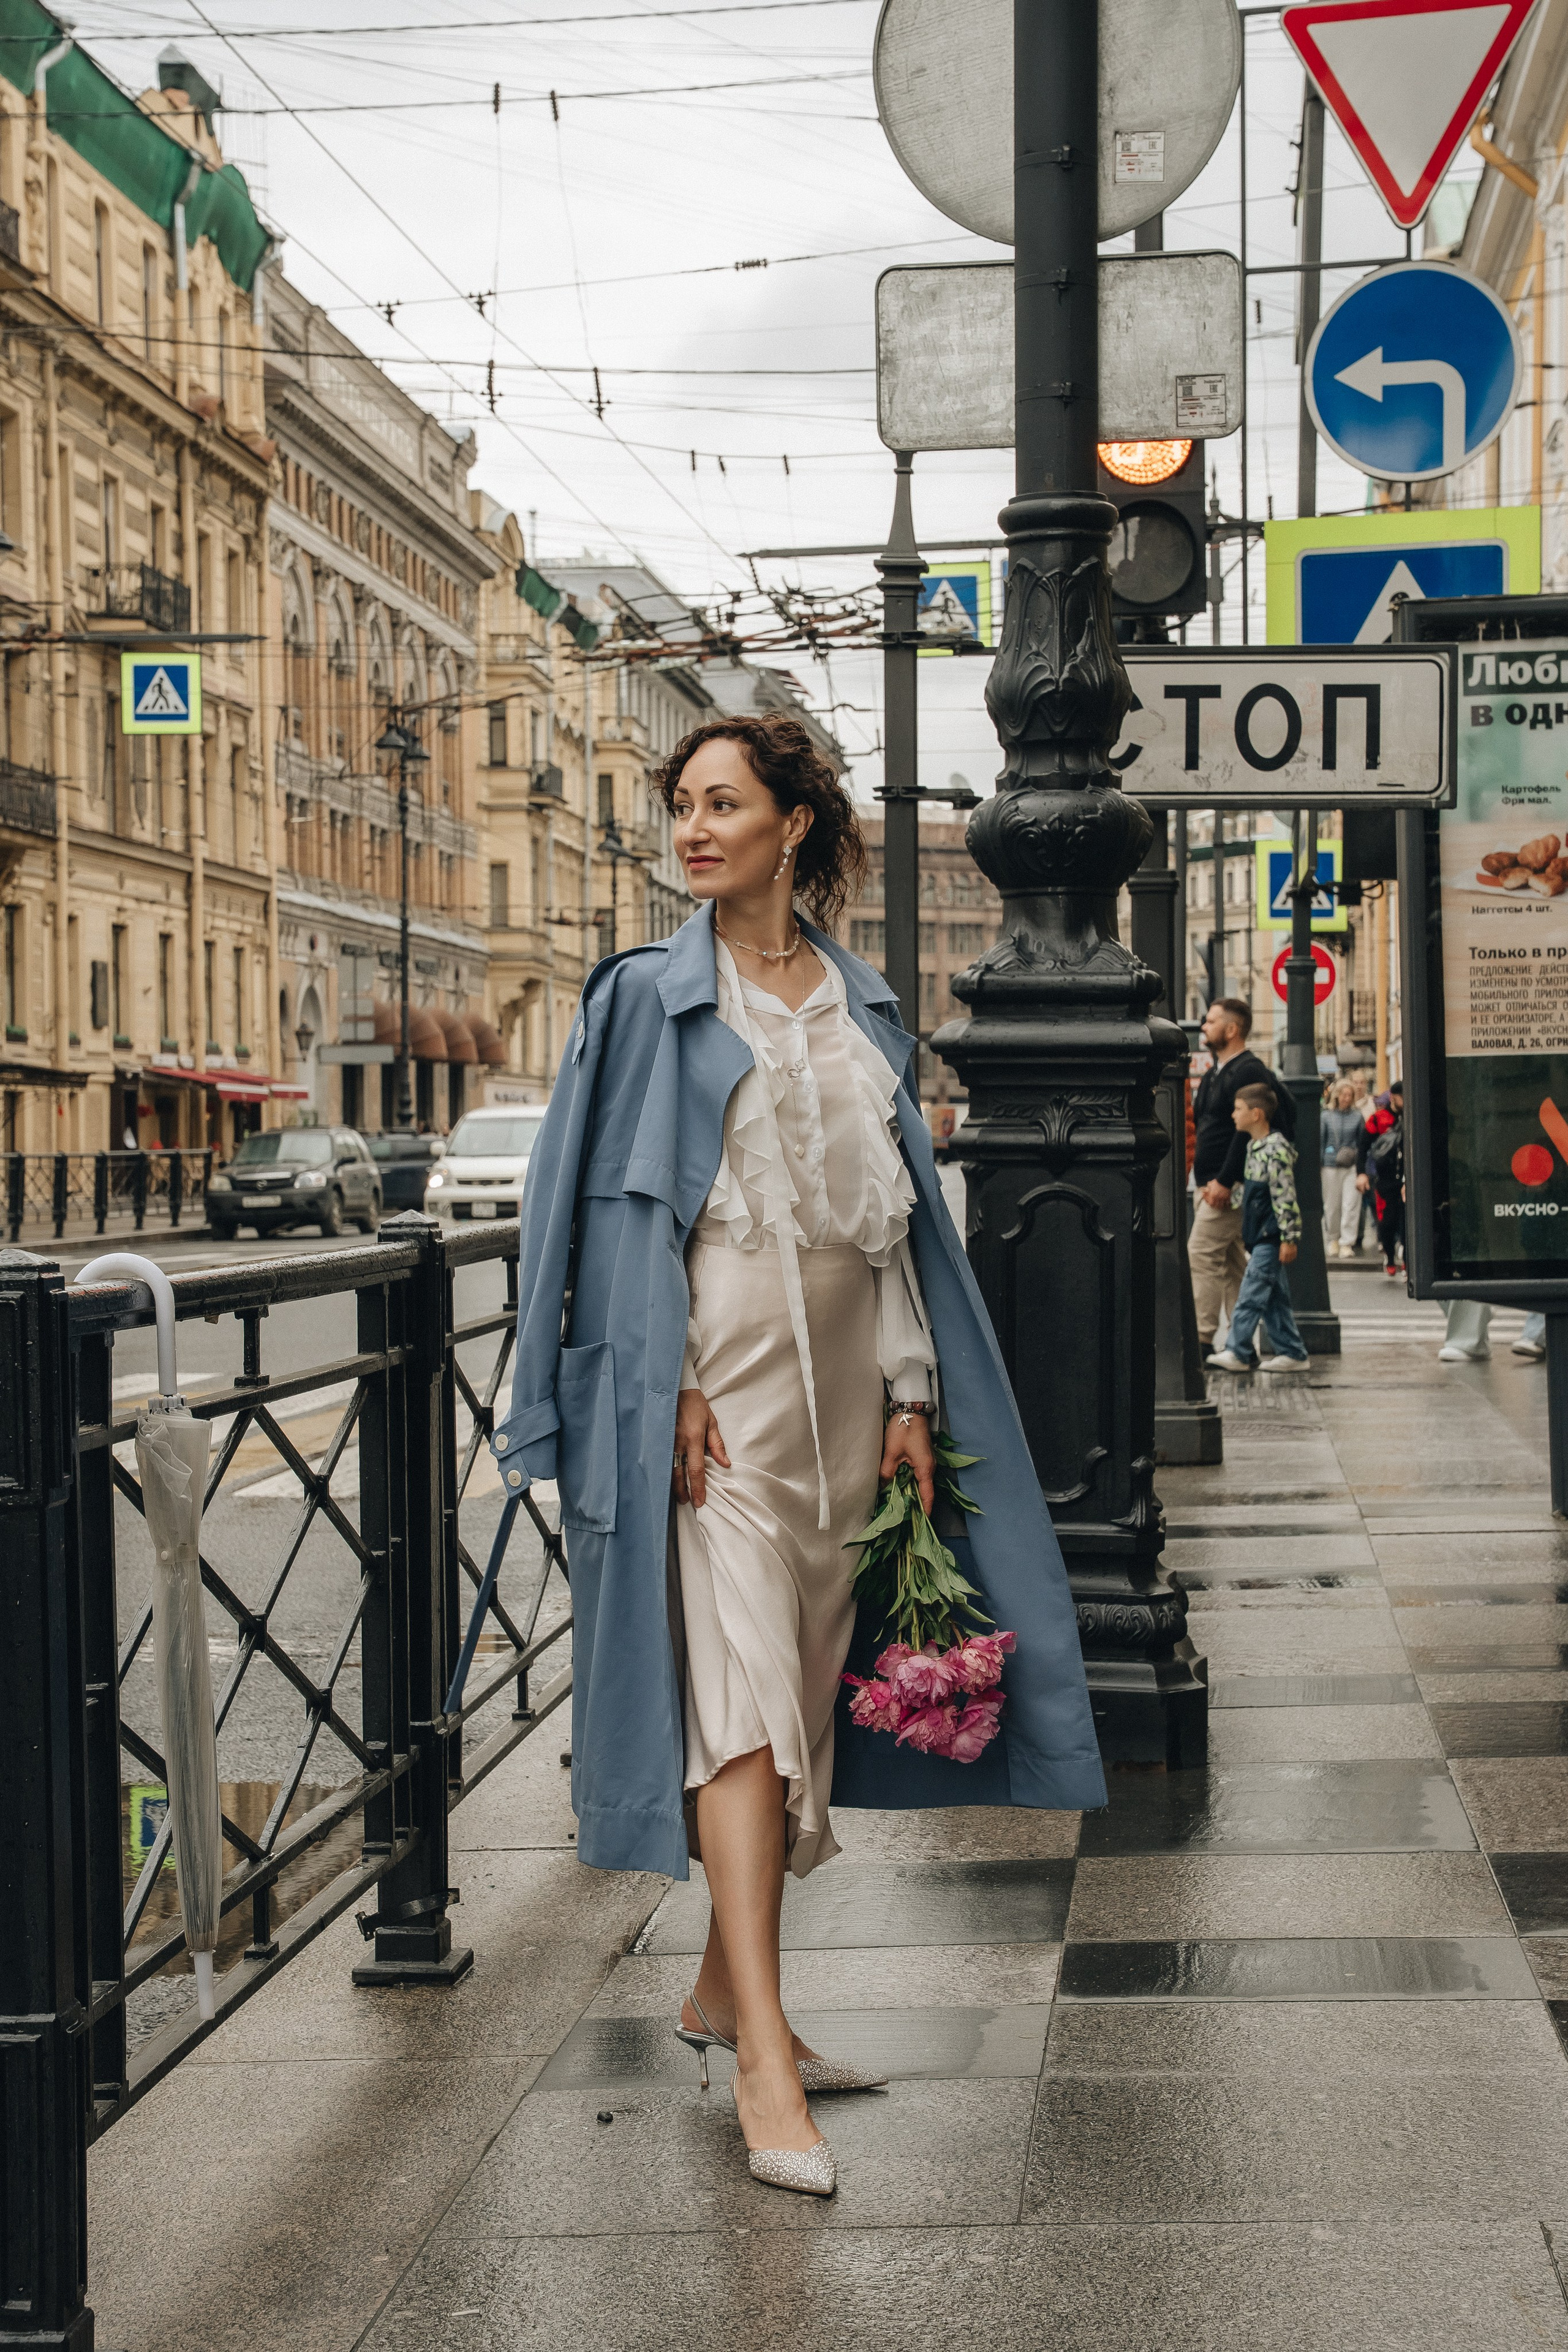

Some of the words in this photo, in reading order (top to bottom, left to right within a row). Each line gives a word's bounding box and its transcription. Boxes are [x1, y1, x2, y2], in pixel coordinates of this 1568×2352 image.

[1471, 705, 1494, 727] в
[1502, 785, 1561, 794] Картофель
[1501, 797, 1525, 806] Фри
[1472, 906, 1523, 914] Наггетсы
[1469, 947, 1527, 959] Только
[1532, 949, 1542, 957] в
[1470, 965, 1532, 977] ПРЕДЛОЖЕНИЕ
[1471, 978, 1517, 988] ИЗМЕНЕНЫ
[1521, 977, 1532, 986] ПО
[1471, 990, 1528, 1000] МОБИЛЬНОГО
[1471, 1001, 1500, 1012] МОЖЕТ
[1506, 1000, 1557, 1011] ОТЛИЧАТЬСЯ
[1471, 1016, 1477, 1024] И
[1480, 1014, 1490, 1025] ЕЕ
[1559, 1012, 1565, 1022] А
[1471, 1027, 1531, 1036] ПРИЛОЖЕНИИ
[1472, 1038, 1515, 1049] ВАЛОВАЯ,
[1530, 1038, 1543, 1048] 26,
[1494, 1202, 1559, 1217] ВКУСНО
